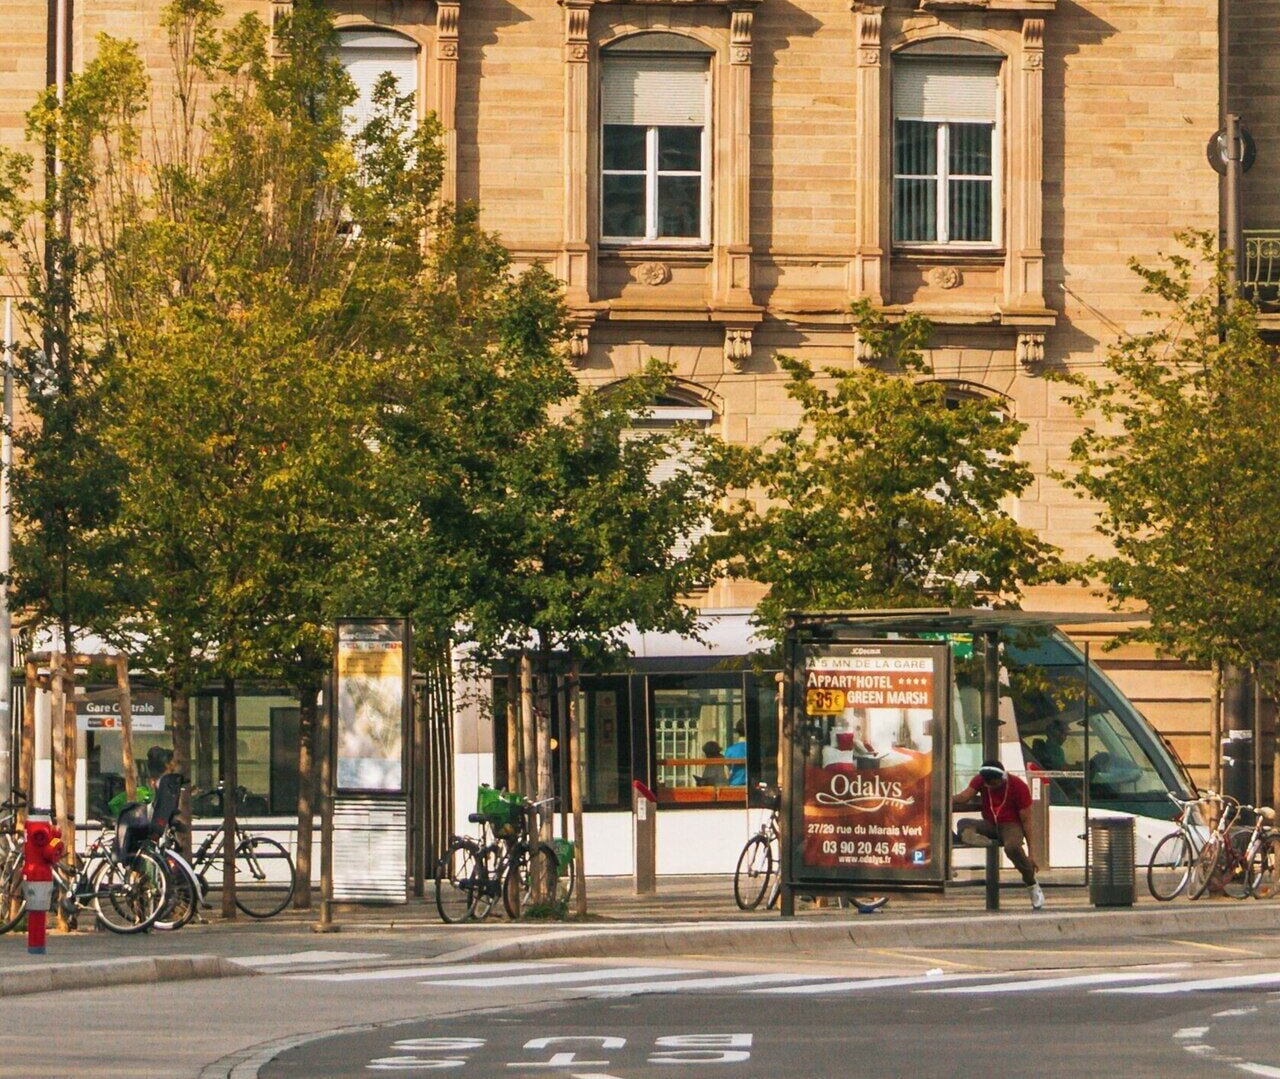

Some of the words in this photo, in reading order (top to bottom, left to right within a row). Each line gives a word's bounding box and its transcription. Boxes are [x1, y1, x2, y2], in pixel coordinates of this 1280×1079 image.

[832, 660, 851, 668] MN
[894, 660, 925, 668] GARE
[847, 691, 883, 704] GREEN
[887, 692, 928, 705] MARSH
[86, 703, 111, 712] Gare
[112, 703, 154, 712] Ctrale
[830, 774, 902, 799] Odalys
[808, 824, 834, 834] 27/29
[836, 826, 852, 834] rue
[854, 824, 866, 834] du
[868, 825, 900, 835] Marais
[901, 825, 922, 836] Vert
[822, 840, 837, 854] 03
[840, 841, 855, 854] 90
[857, 841, 872, 854] 20
[874, 842, 889, 855] 45
[891, 843, 906, 856] 45
[839, 855, 891, 865] www.odalys.fr
